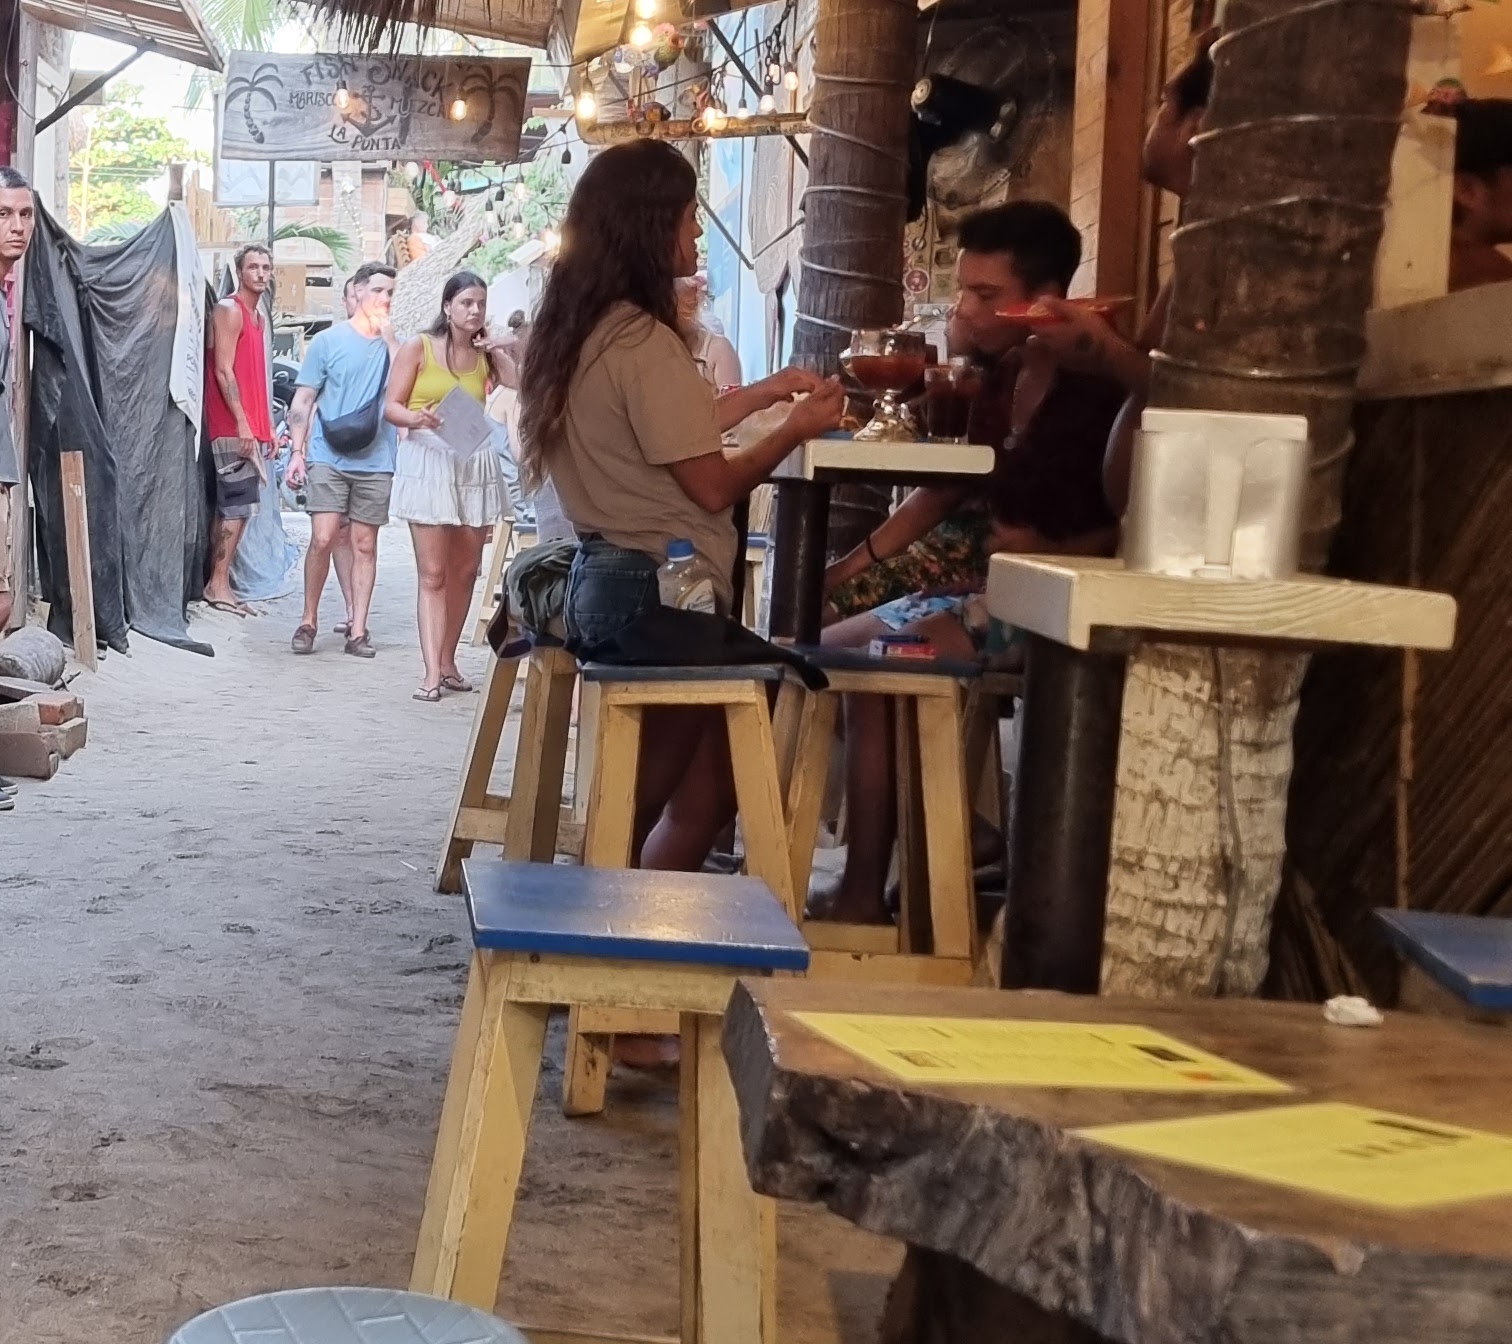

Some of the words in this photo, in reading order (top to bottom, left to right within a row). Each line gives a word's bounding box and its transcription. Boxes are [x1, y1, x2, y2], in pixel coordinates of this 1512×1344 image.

[300, 55, 359, 85] FISH
[367, 58, 454, 102] SNACK
[328, 124, 349, 144] LA
[351, 135, 402, 151] PUNTA
